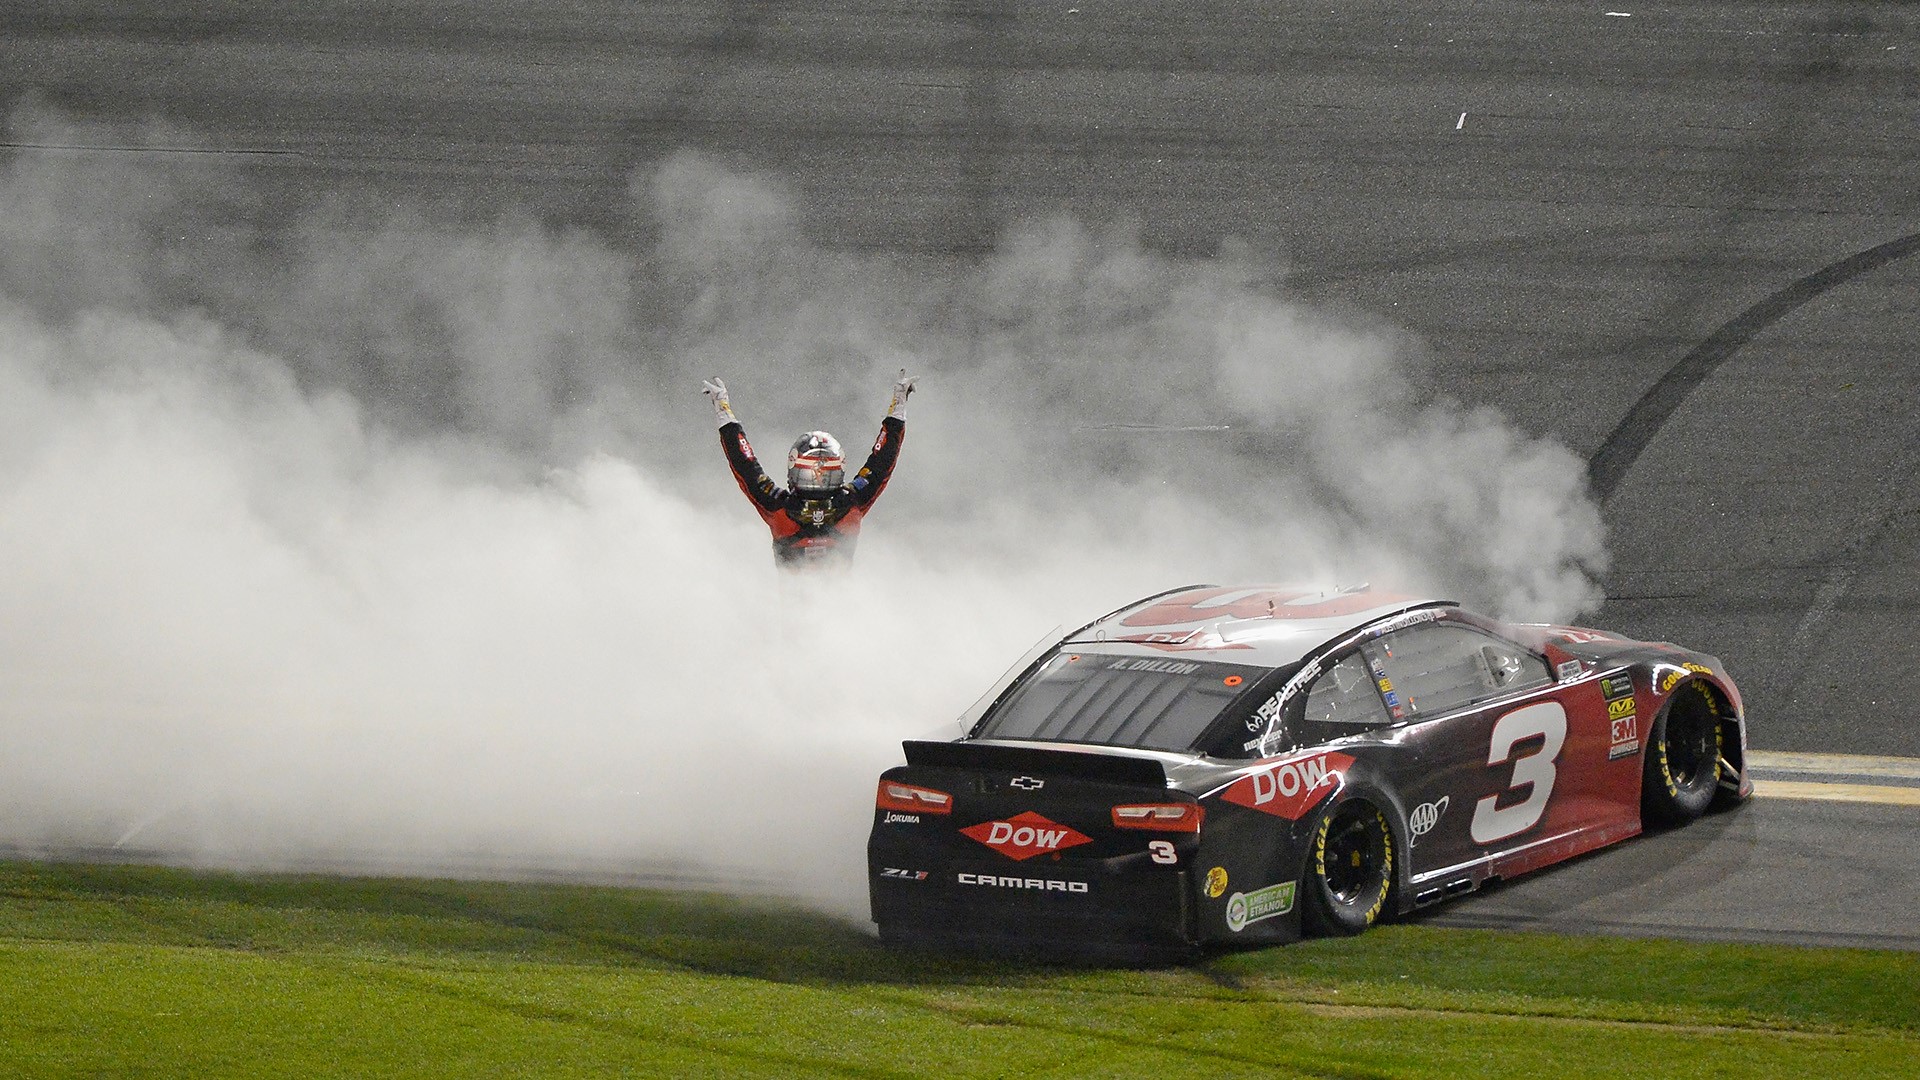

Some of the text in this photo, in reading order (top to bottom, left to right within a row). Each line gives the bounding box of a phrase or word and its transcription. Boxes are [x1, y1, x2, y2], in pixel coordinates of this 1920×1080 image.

[1107, 658, 1201, 675] A. DILLON
[1613, 719, 1636, 741] 3M
[1252, 755, 1331, 806] DOW
[1471, 701, 1567, 844] 3
[890, 814, 920, 824] OKUMA
[1411, 805, 1437, 834] AAA
[1148, 840, 1178, 864] 3
[1315, 816, 1330, 875] EAGLE
[957, 873, 1089, 893] CAMARO
[1250, 899, 1287, 917] ETHANOL
